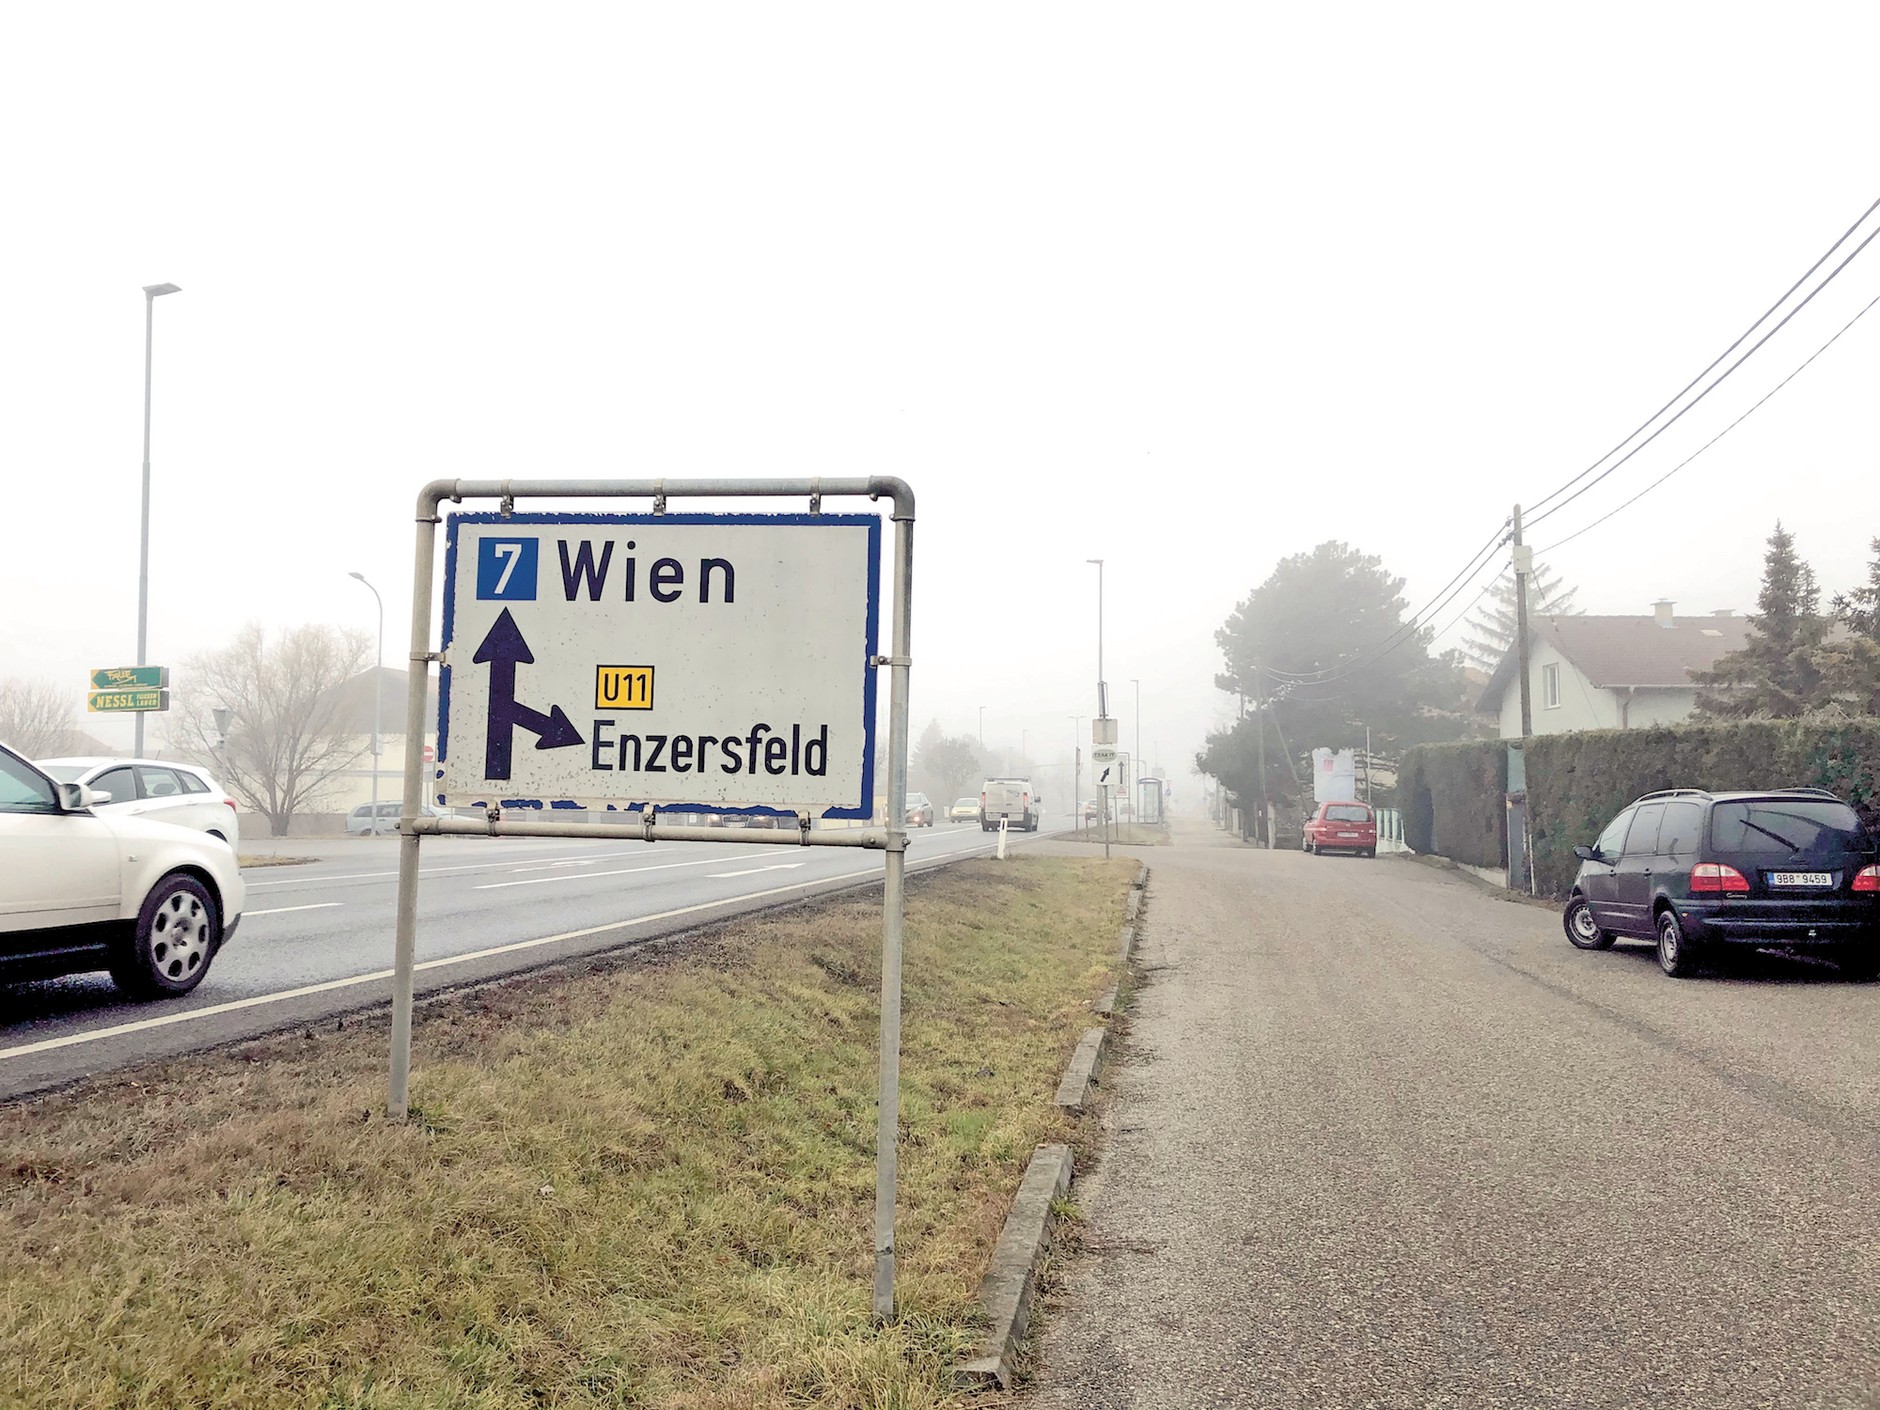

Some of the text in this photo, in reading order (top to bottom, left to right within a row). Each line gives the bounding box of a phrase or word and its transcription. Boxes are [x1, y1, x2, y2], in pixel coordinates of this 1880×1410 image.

[493, 543, 523, 595] 7
[557, 539, 735, 604] Wien
[95, 694, 134, 708] NESSL
[603, 672, 647, 702] U11
[591, 718, 828, 777] Enzersfeld
[1776, 874, 1828, 884] 9B8 9459
